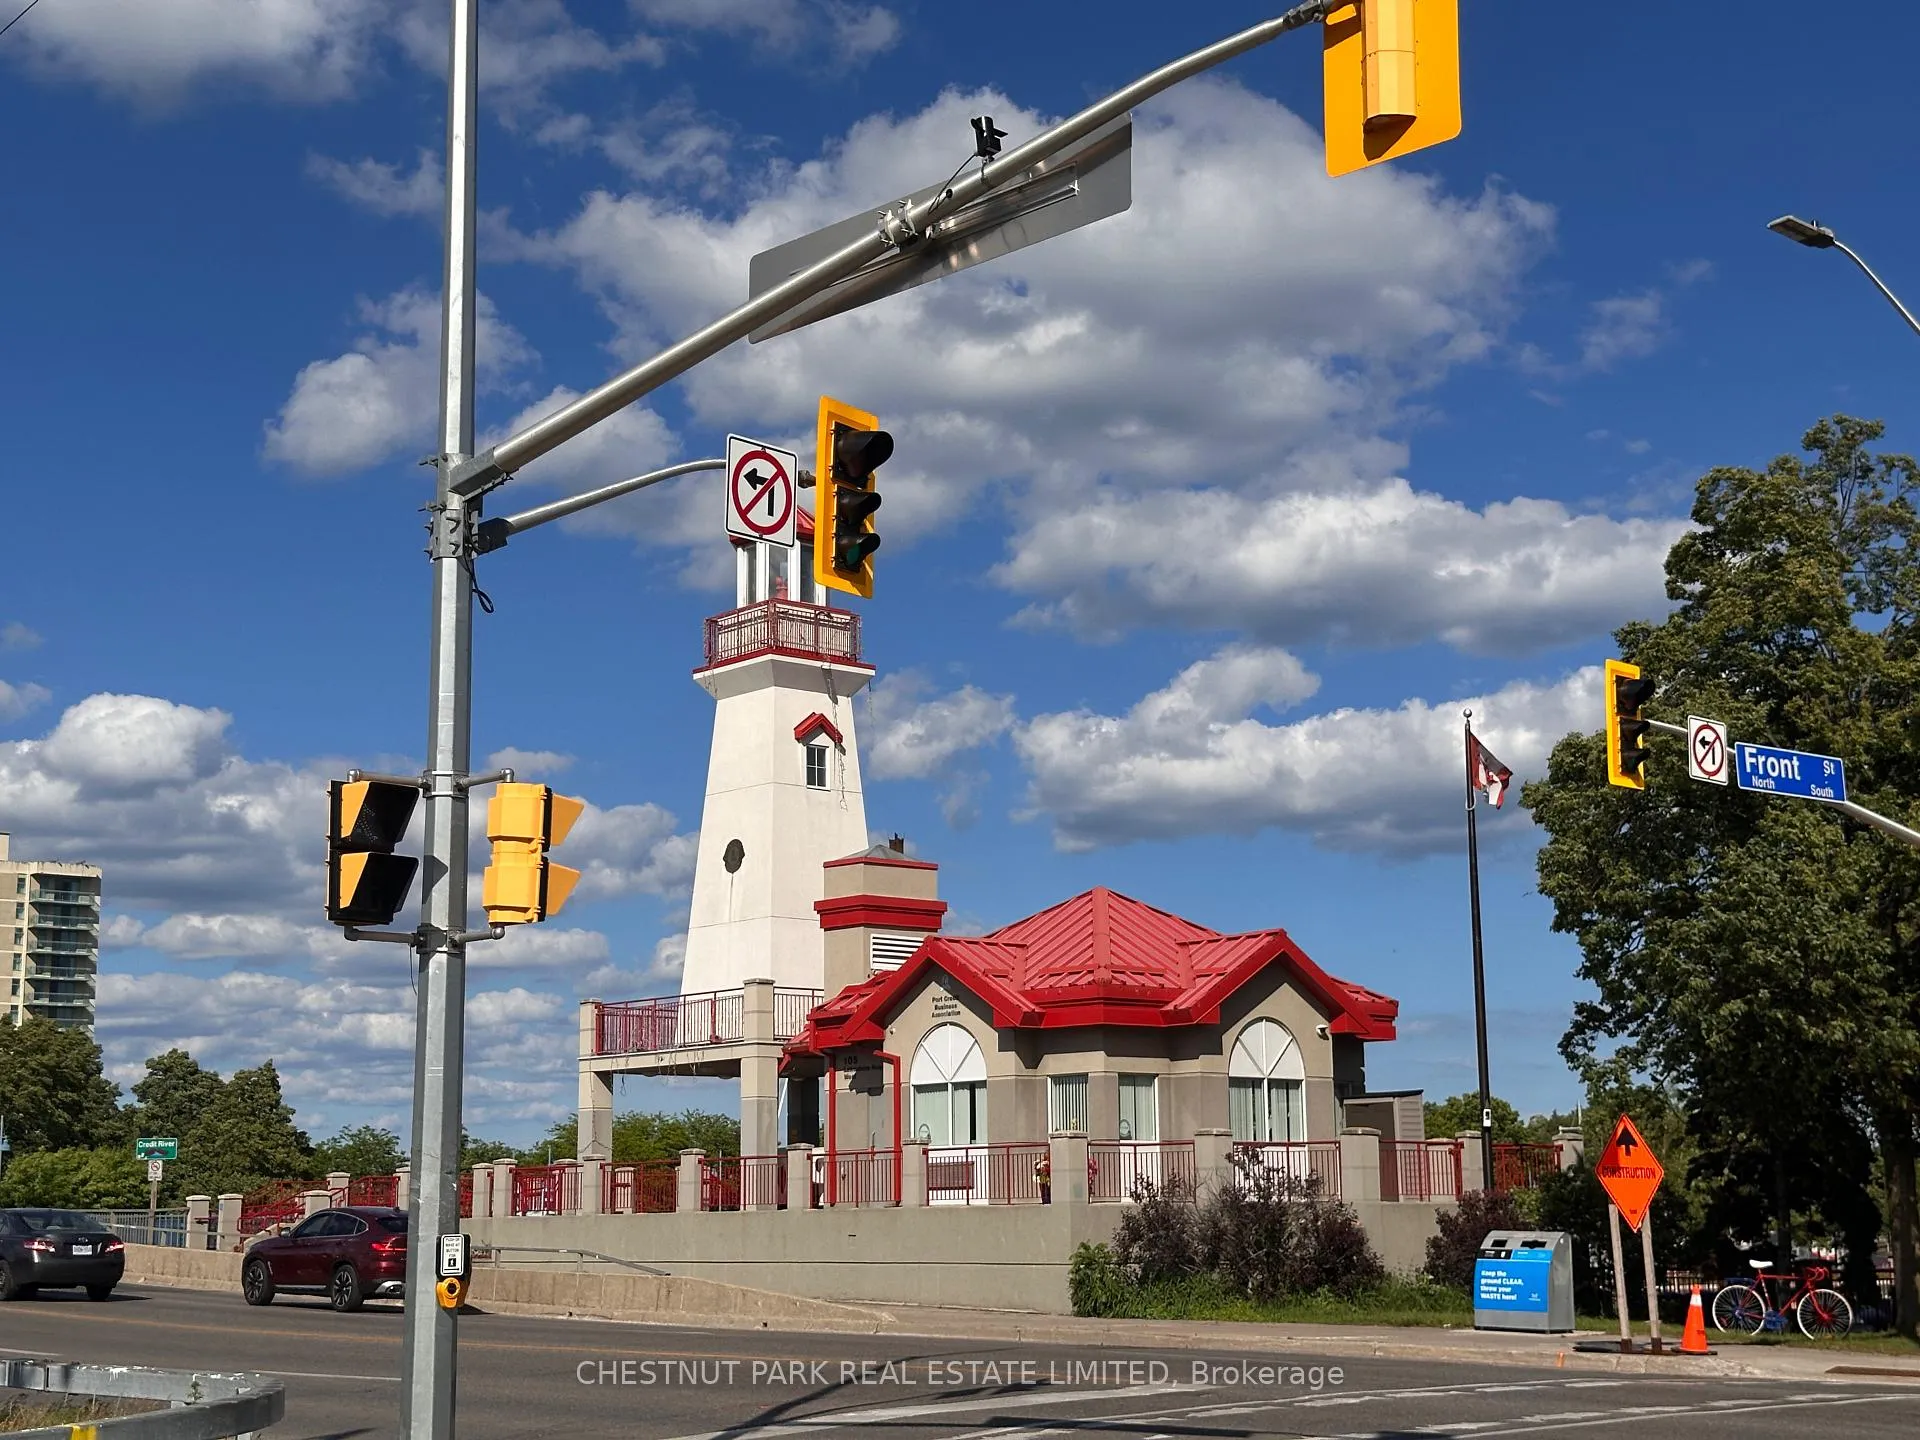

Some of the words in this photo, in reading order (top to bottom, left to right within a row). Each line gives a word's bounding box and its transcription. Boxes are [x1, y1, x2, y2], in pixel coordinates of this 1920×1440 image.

[1744, 747, 1801, 780] Front
[1823, 760, 1835, 775] St
[1752, 775, 1775, 789] North
[1810, 784, 1834, 798] South
[1602, 1166, 1656, 1179] CONSTRUCTION
